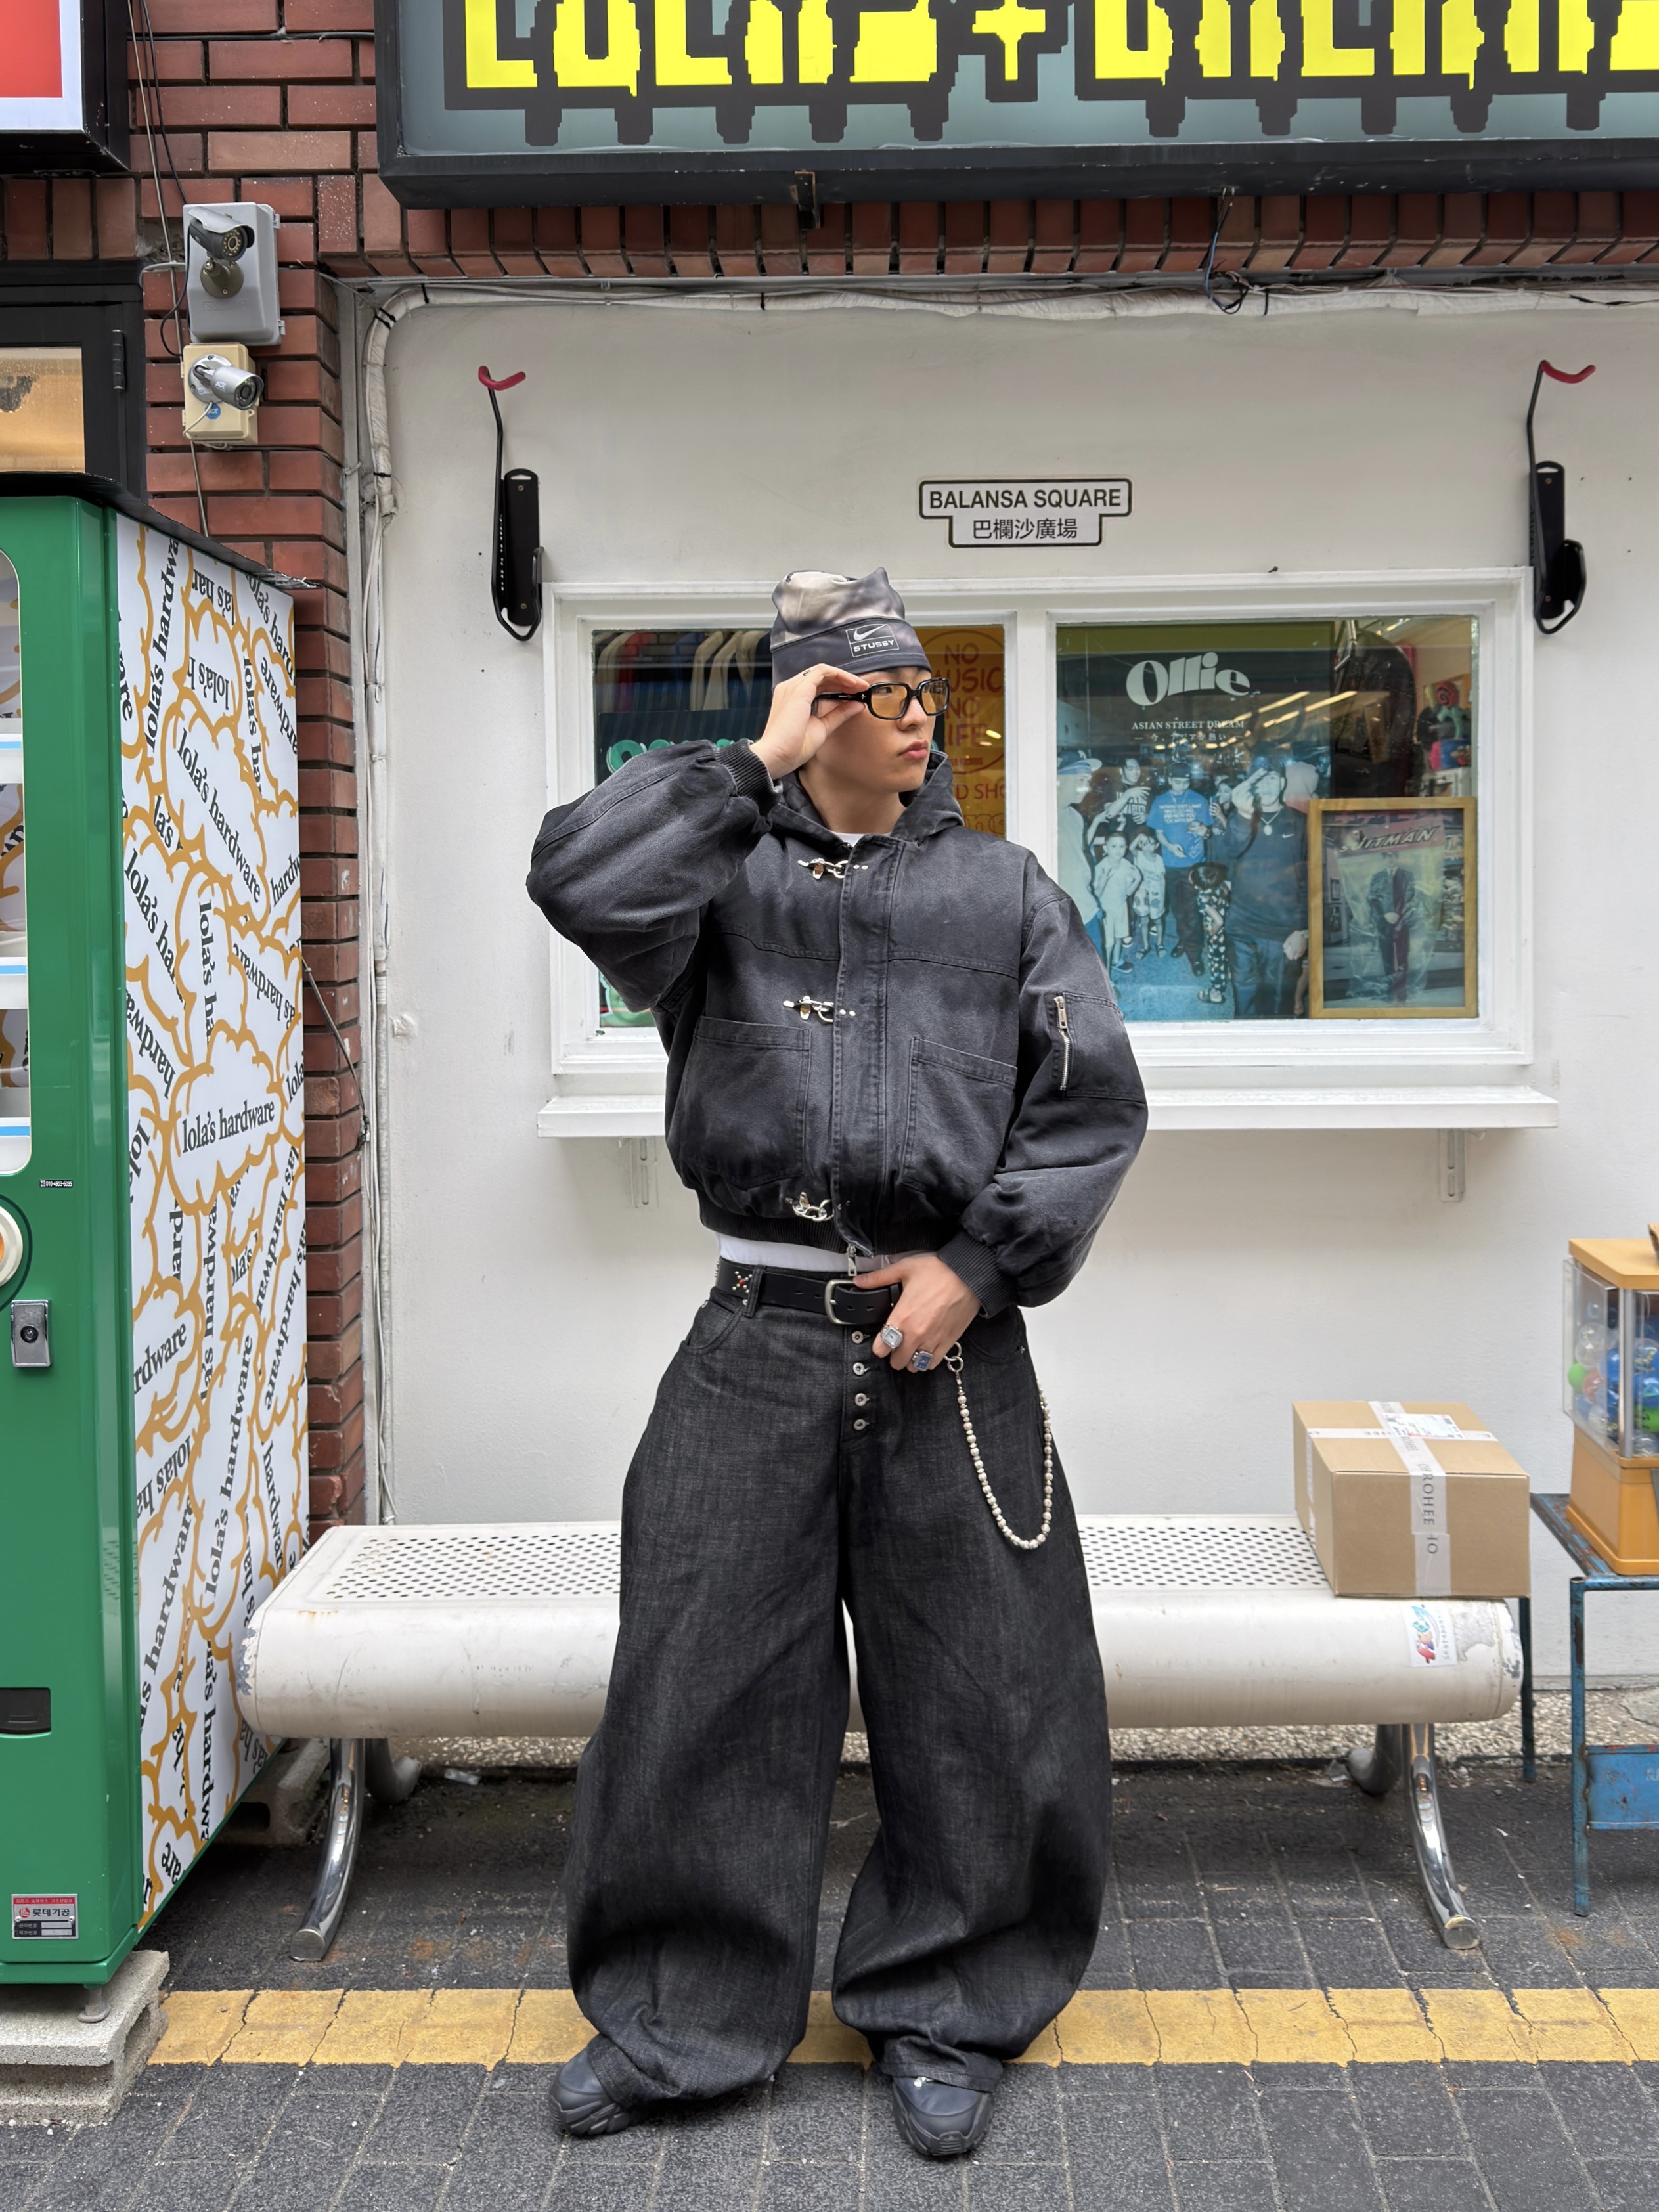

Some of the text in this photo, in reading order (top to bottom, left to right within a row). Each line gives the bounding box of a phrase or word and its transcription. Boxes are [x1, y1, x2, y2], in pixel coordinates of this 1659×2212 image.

[929, 488, 1121, 509] BALANSA SQUARE
[853, 639, 895, 652] STUSSY
[944, 642, 979, 665] NO
[199, 663, 230, 711] lola's
[933, 667, 1002, 694] USIC
[1126, 652, 1250, 707] Ollie
[944, 723, 988, 747] IFE
[1132, 720, 1245, 730] ASIAN STREET DREAM
[177, 728, 261, 903] lola's hardware
[124, 847, 158, 934] lola's
[199, 899, 215, 986] lola's
[182, 1099, 275, 1154] lola's hardware
[205, 1335, 253, 1598] lola's hardware
[32, 1908, 70, 1917] 롯데기공
